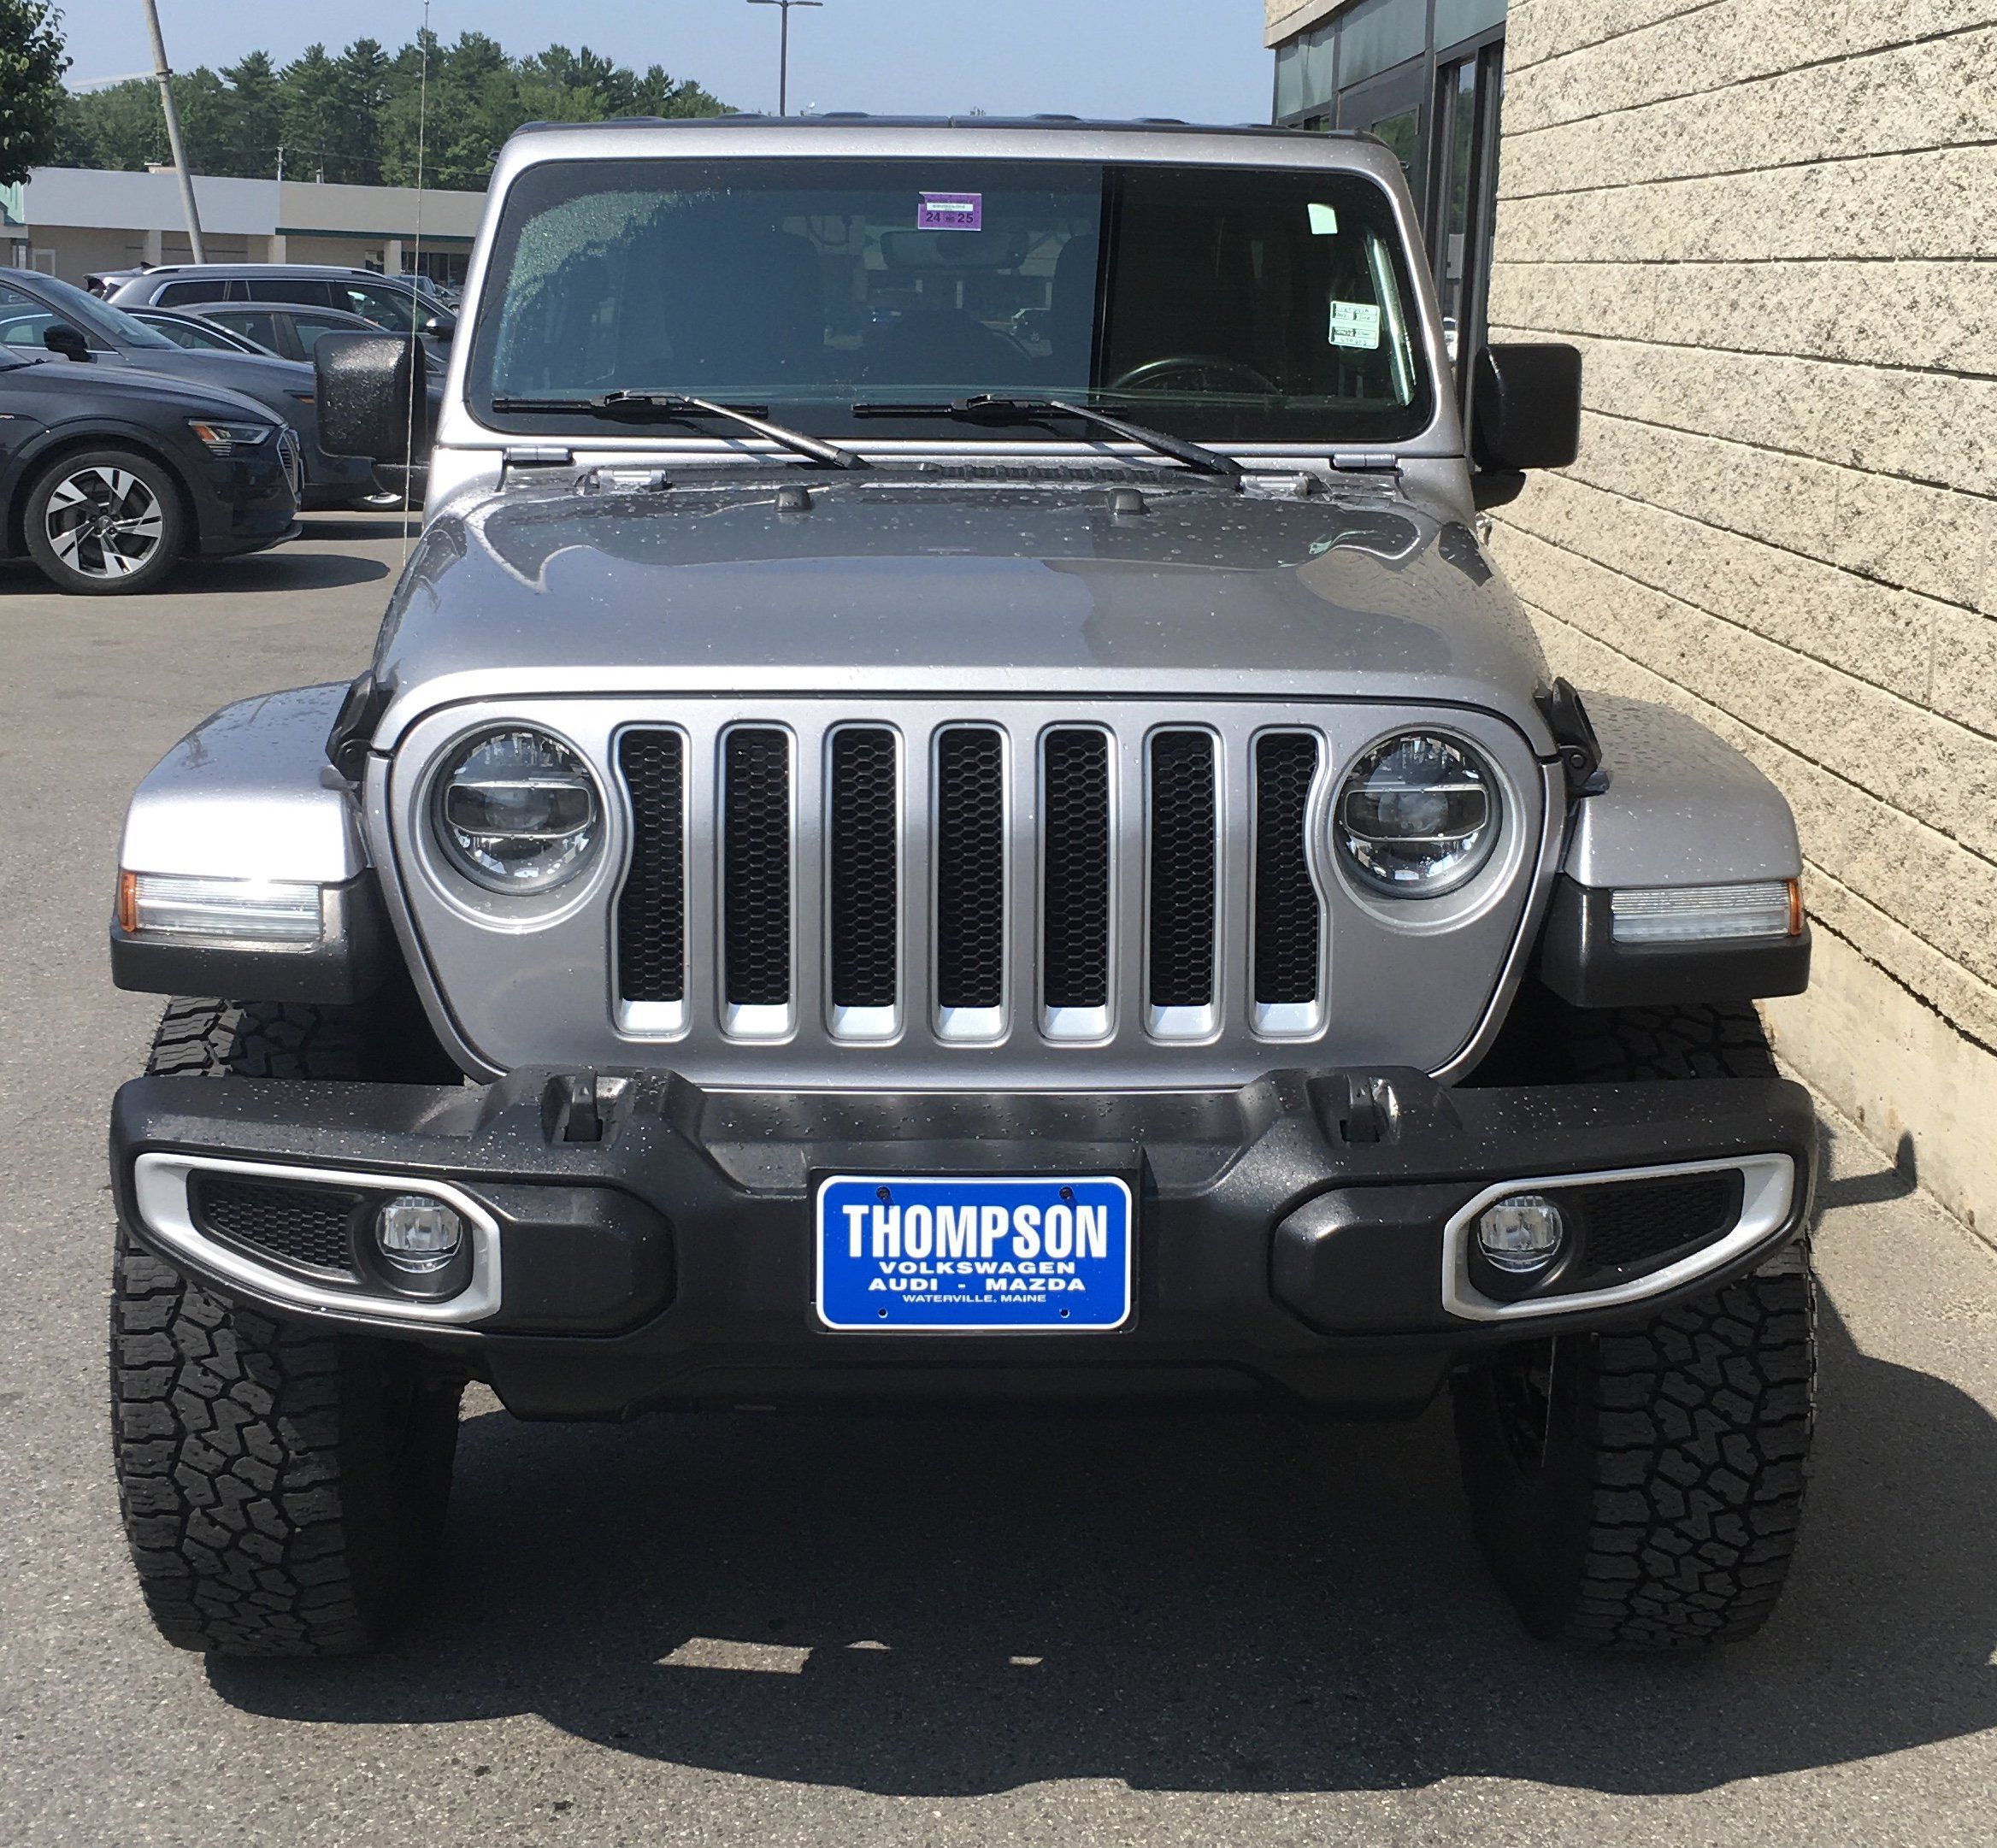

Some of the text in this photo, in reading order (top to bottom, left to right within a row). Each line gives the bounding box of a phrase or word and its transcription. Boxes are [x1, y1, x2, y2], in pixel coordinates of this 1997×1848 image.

[925, 212, 974, 223] 24 25
[842, 1204, 1107, 1258] THOMPSON
[879, 1262, 1075, 1274] VOLKSWAGEN
[868, 1278, 938, 1291] AUDI
[986, 1278, 1086, 1291] MAZDA
[1000, 1294, 1046, 1303] MAINE
